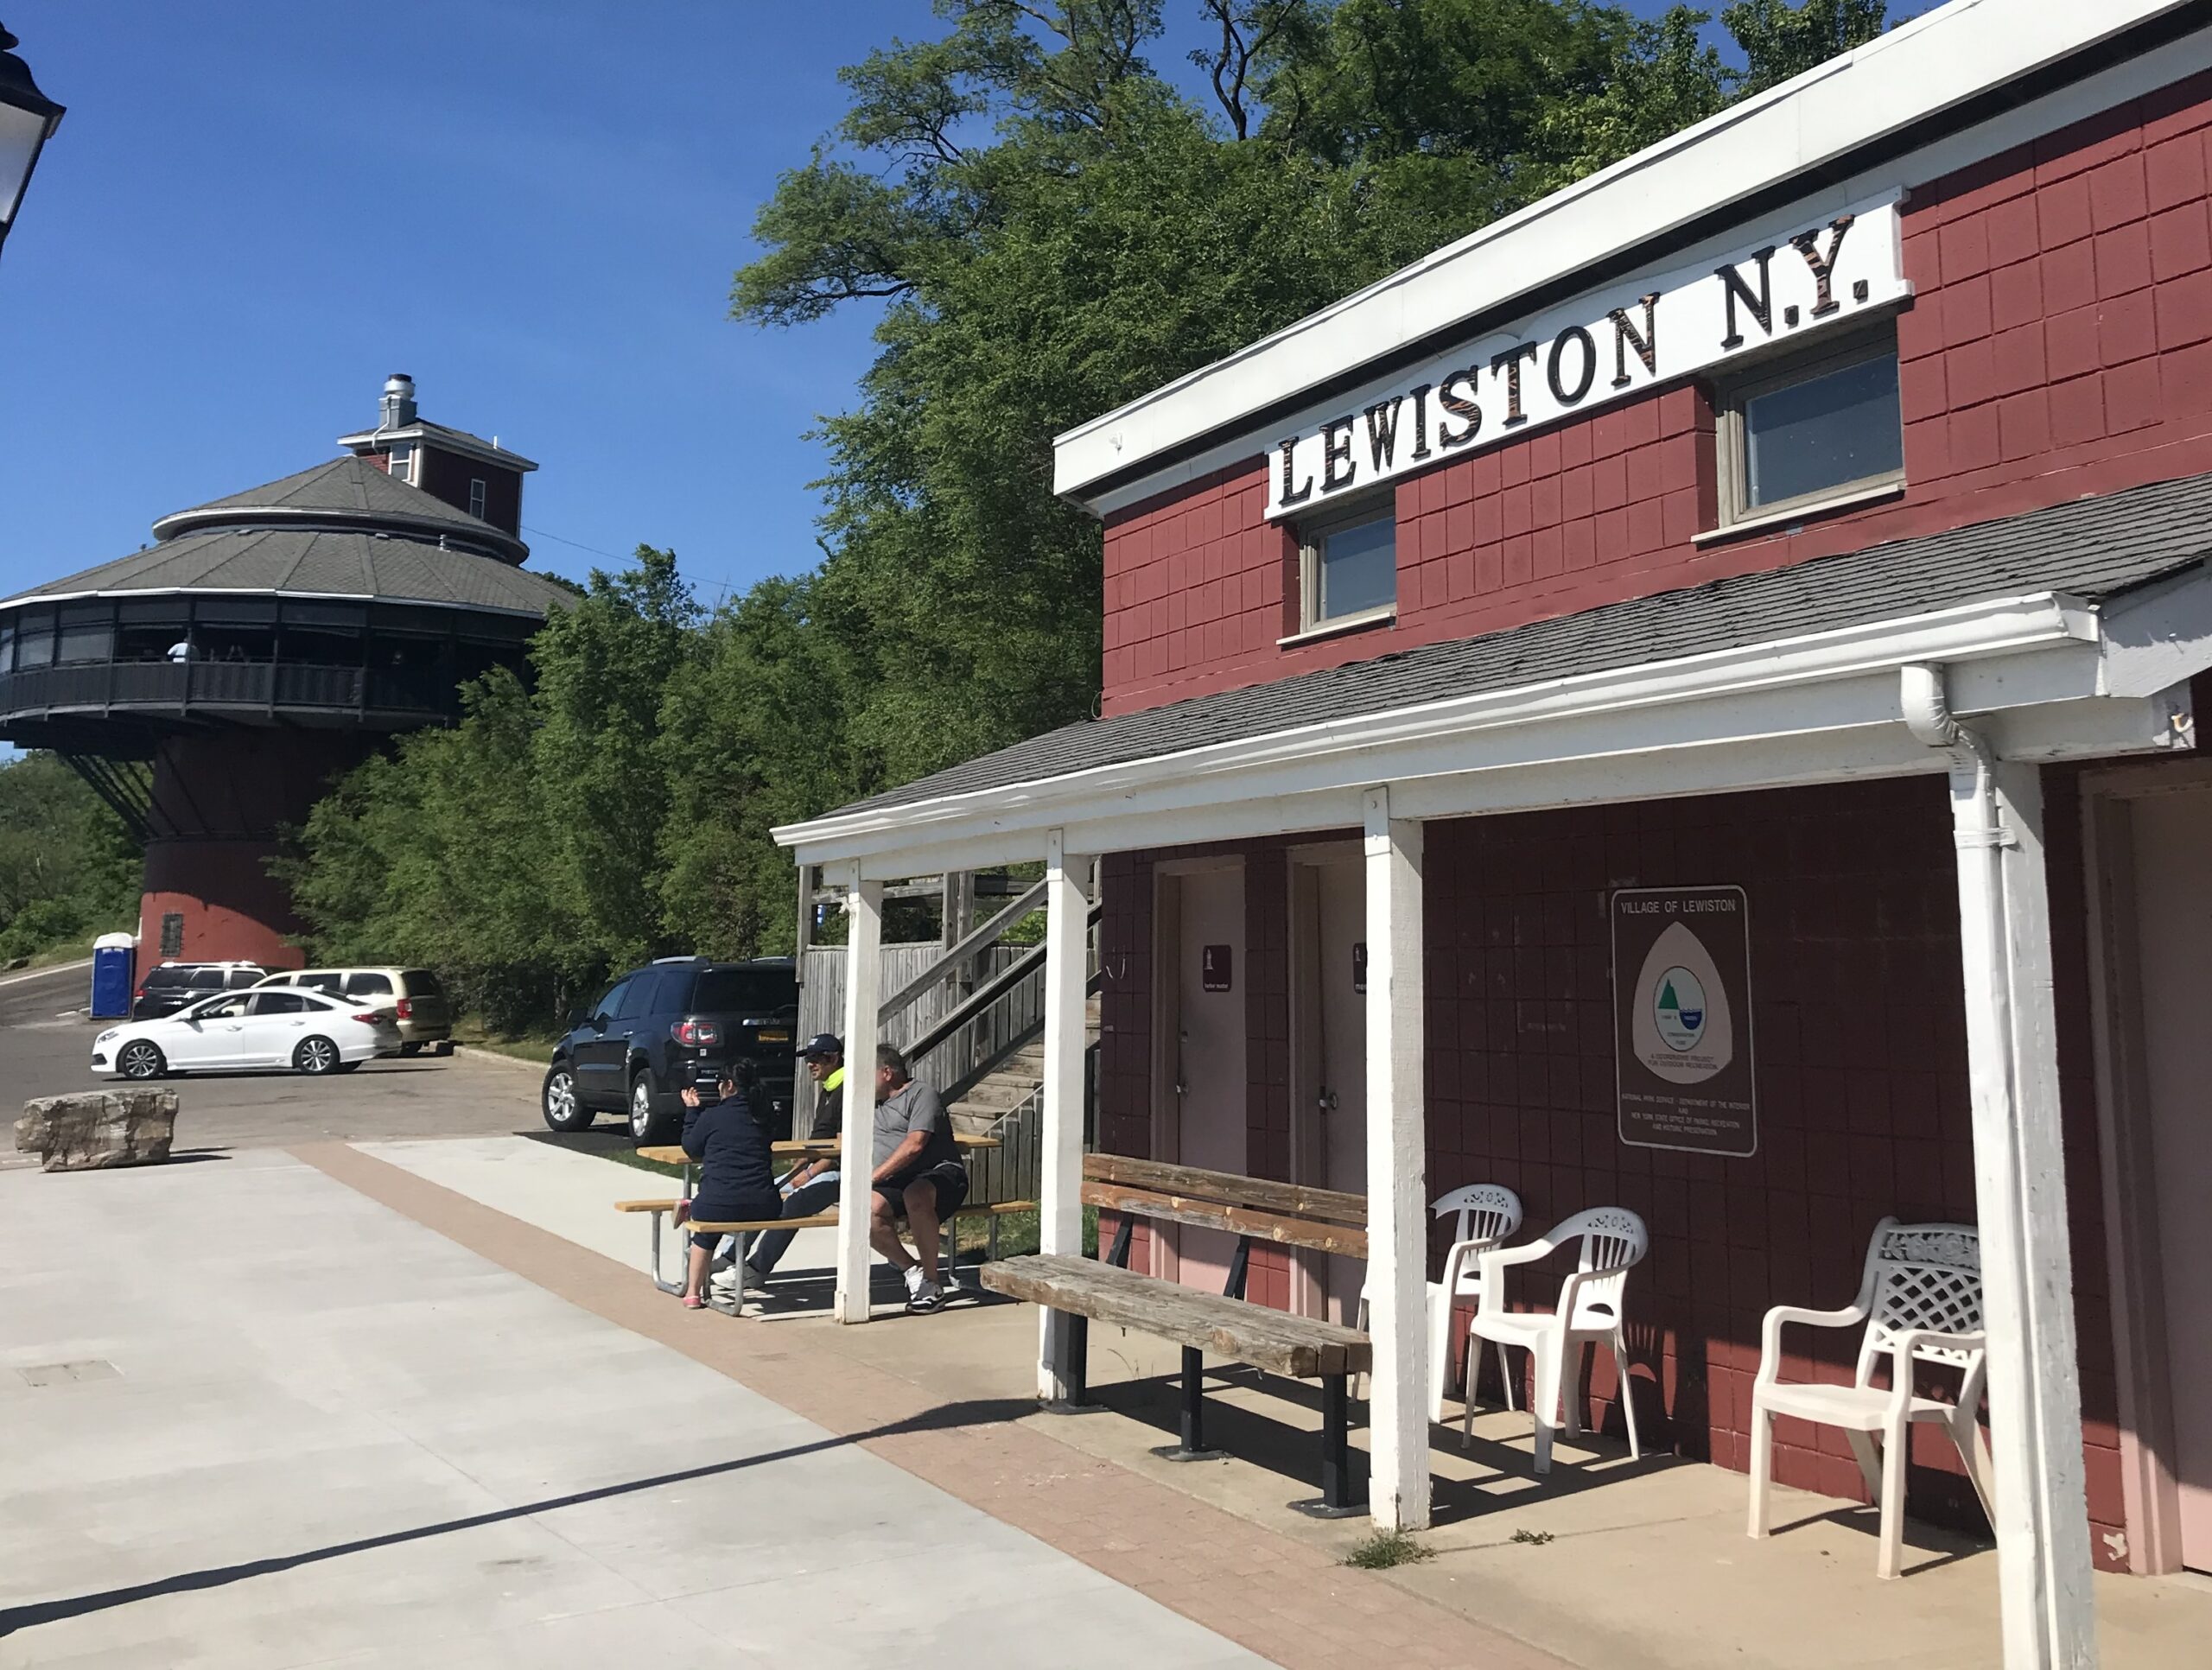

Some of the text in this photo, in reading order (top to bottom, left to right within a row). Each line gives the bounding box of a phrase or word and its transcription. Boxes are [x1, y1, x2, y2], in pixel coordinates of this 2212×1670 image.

[1277, 213, 1869, 506] LEWISTON N.Y.
[1620, 898, 1736, 914] VILLAGE OF LEWISTON
